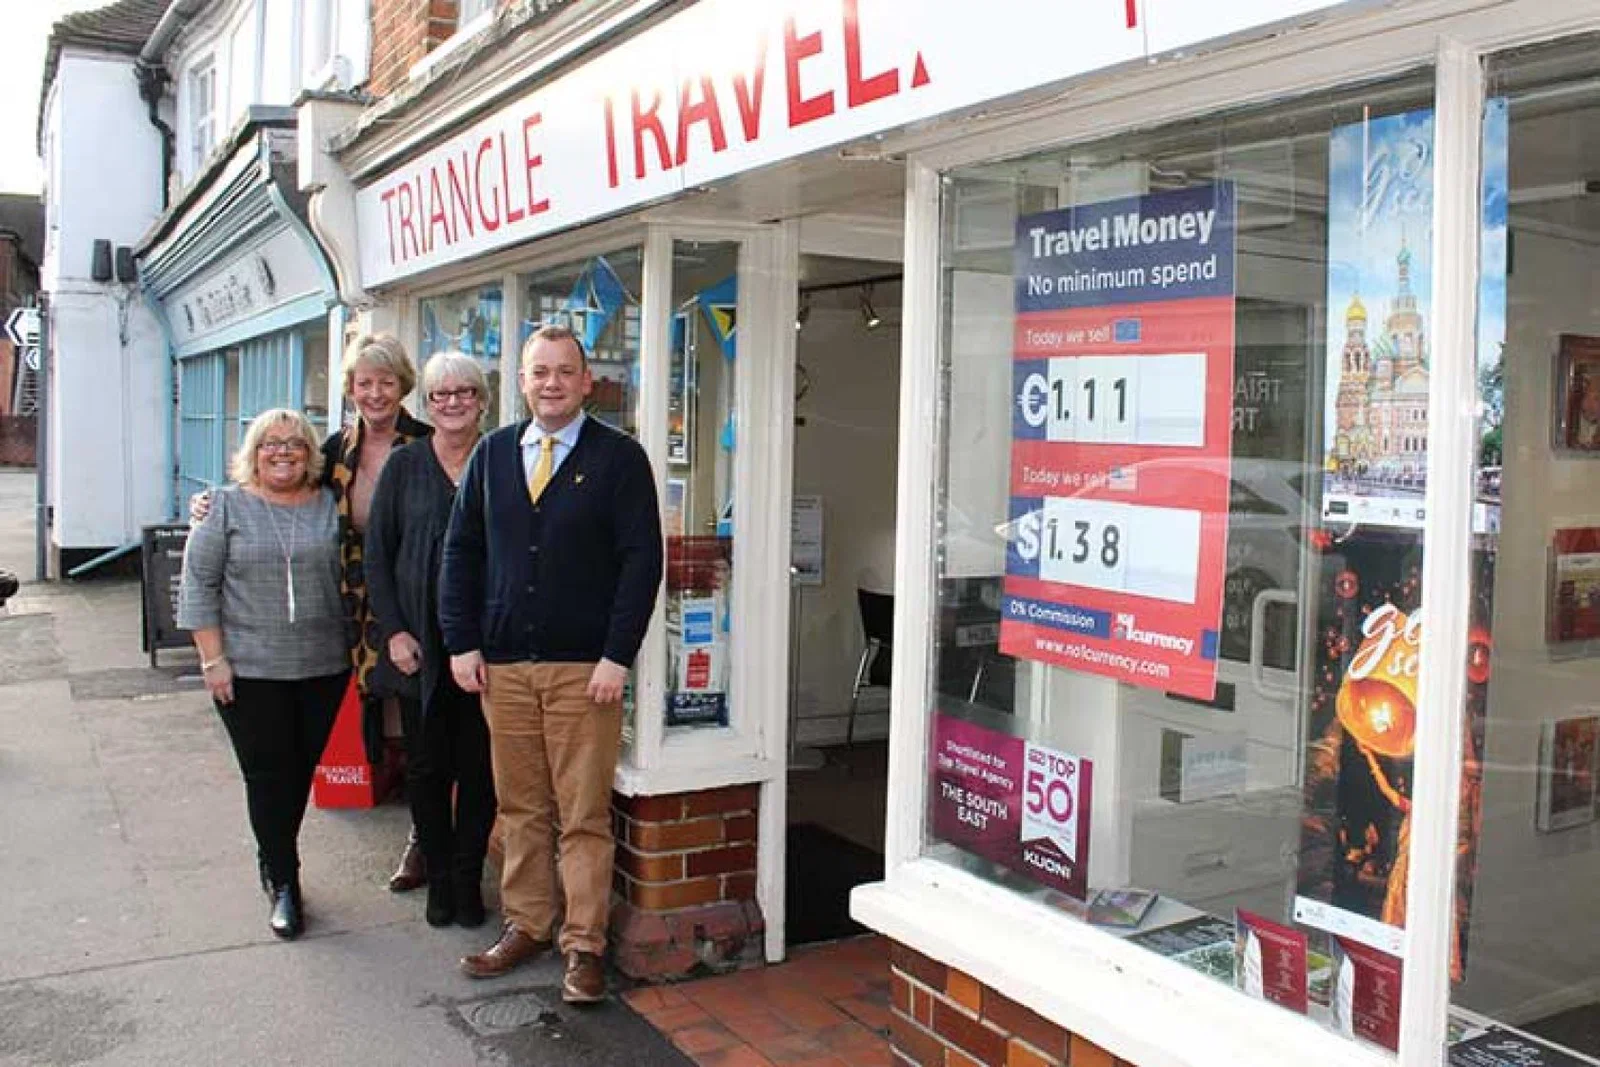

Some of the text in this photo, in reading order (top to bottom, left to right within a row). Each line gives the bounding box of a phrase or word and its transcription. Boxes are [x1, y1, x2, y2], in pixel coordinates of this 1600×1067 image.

[380, 112, 550, 265] TRIANGLE
[1030, 209, 1215, 258] Travel Money
[1028, 254, 1217, 296] No minimum spend
[1025, 330, 1063, 346] Today
[1066, 330, 1084, 343] we
[1023, 467, 1059, 487] Today
[1028, 604, 1095, 629] Commission
[1047, 754, 1076, 778] TOP
[941, 782, 1008, 820] THE SOUTH
[1026, 769, 1074, 823] 50
[957, 806, 988, 830] EAST
